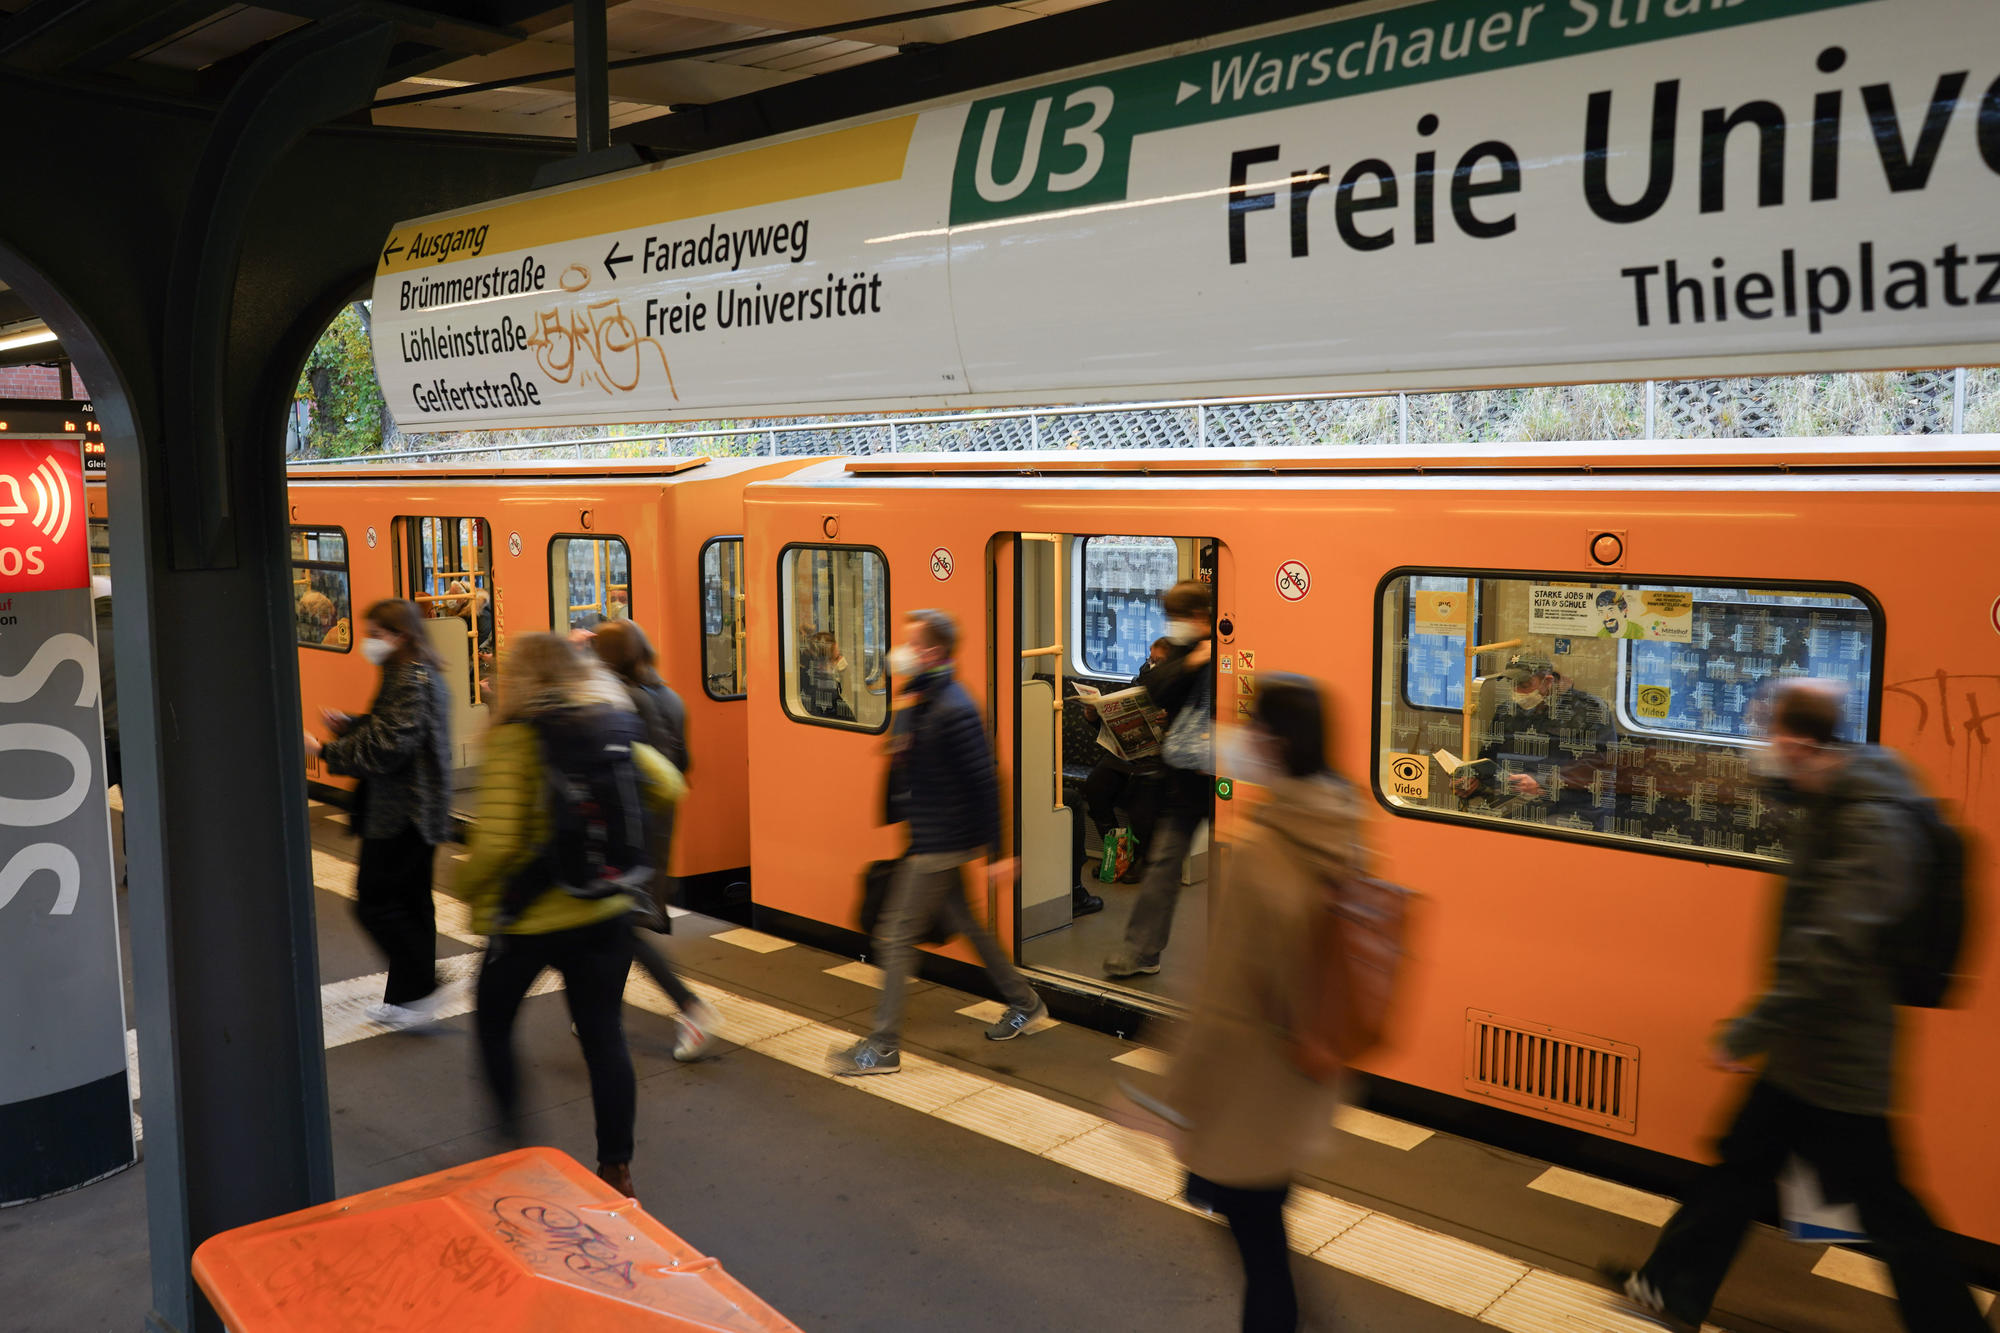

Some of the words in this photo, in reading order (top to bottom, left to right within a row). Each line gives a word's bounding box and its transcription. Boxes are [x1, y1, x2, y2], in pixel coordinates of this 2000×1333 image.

[1210, 2, 1546, 105] Warschauer
[974, 85, 1115, 203] U3
[1228, 113, 1522, 265] Freie
[406, 224, 490, 263] Ausgang
[643, 219, 810, 274] Faradayweg
[400, 255, 546, 311] Brümmerstraße
[646, 291, 707, 337] Freie
[717, 272, 882, 329] Universität
[1621, 241, 2000, 335] Thielplatz
[400, 315, 528, 363] Löhleinstraße
[412, 372, 541, 413] Gelfertstraße
[65, 421, 76, 431] in
[85, 443, 92, 452] 3
[1534, 590, 1562, 599] STARKE
[1564, 591, 1584, 600] JOBS
[1586, 592, 1594, 600] IN
[1534, 599, 1550, 607] KITA
[1559, 601, 1587, 609] SCHULE
[1394, 782, 1423, 796] Video
